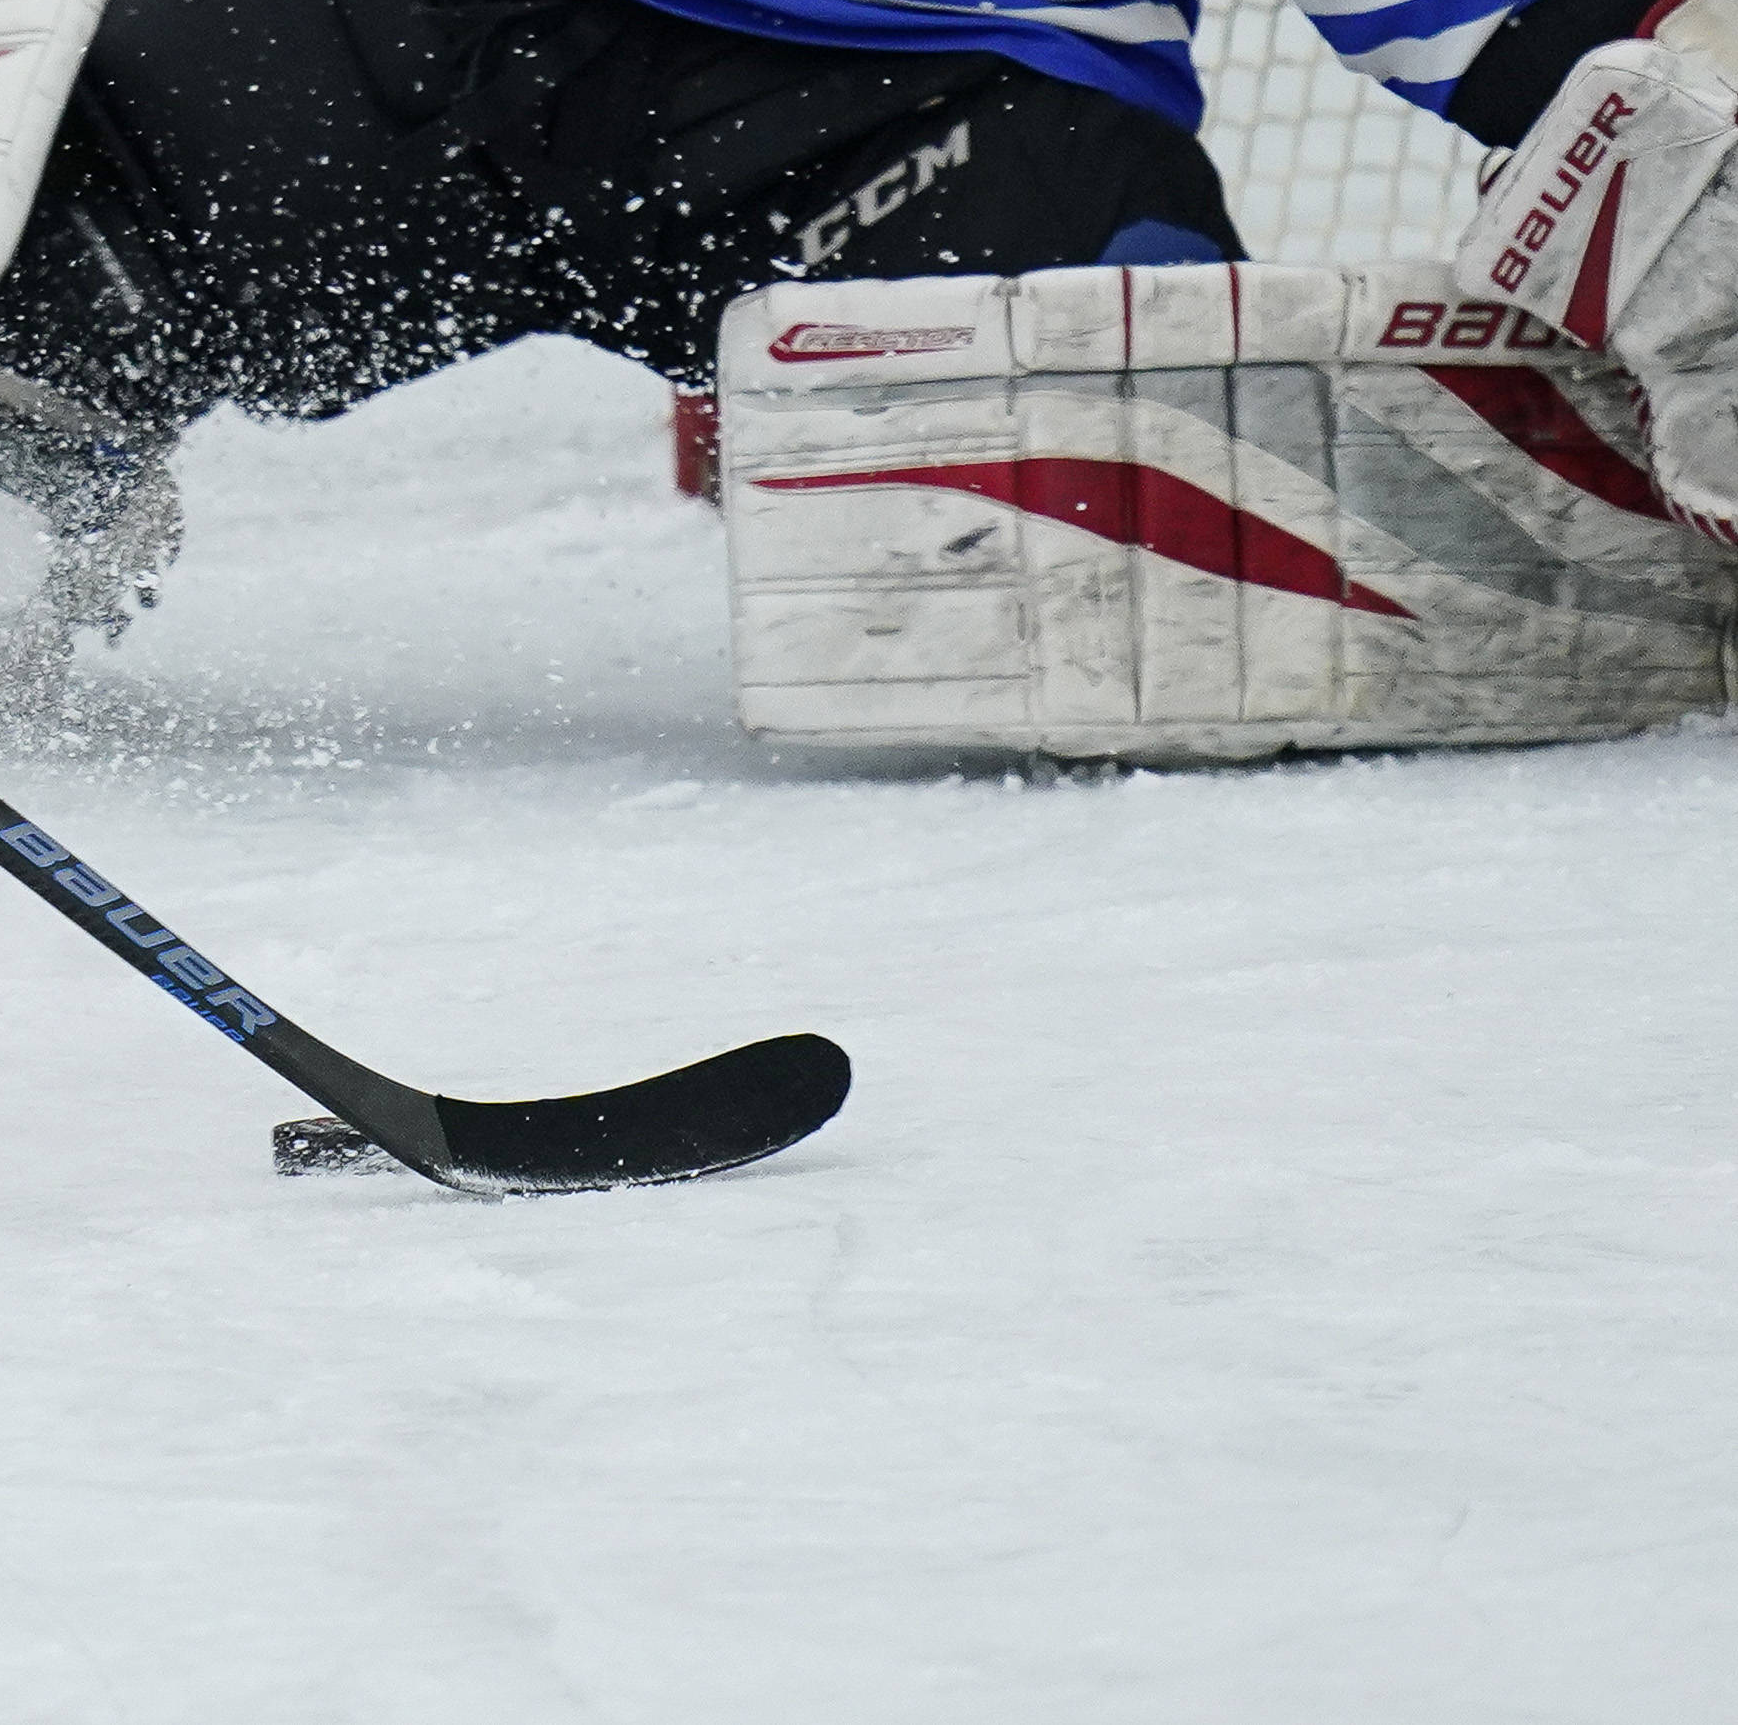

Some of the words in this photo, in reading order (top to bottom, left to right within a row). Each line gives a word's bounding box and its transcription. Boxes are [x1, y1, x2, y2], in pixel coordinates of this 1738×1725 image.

[798, 121, 973, 268] CCM
[1490, 92, 1638, 294] BAUER
[1377, 300, 1561, 350] BAU
